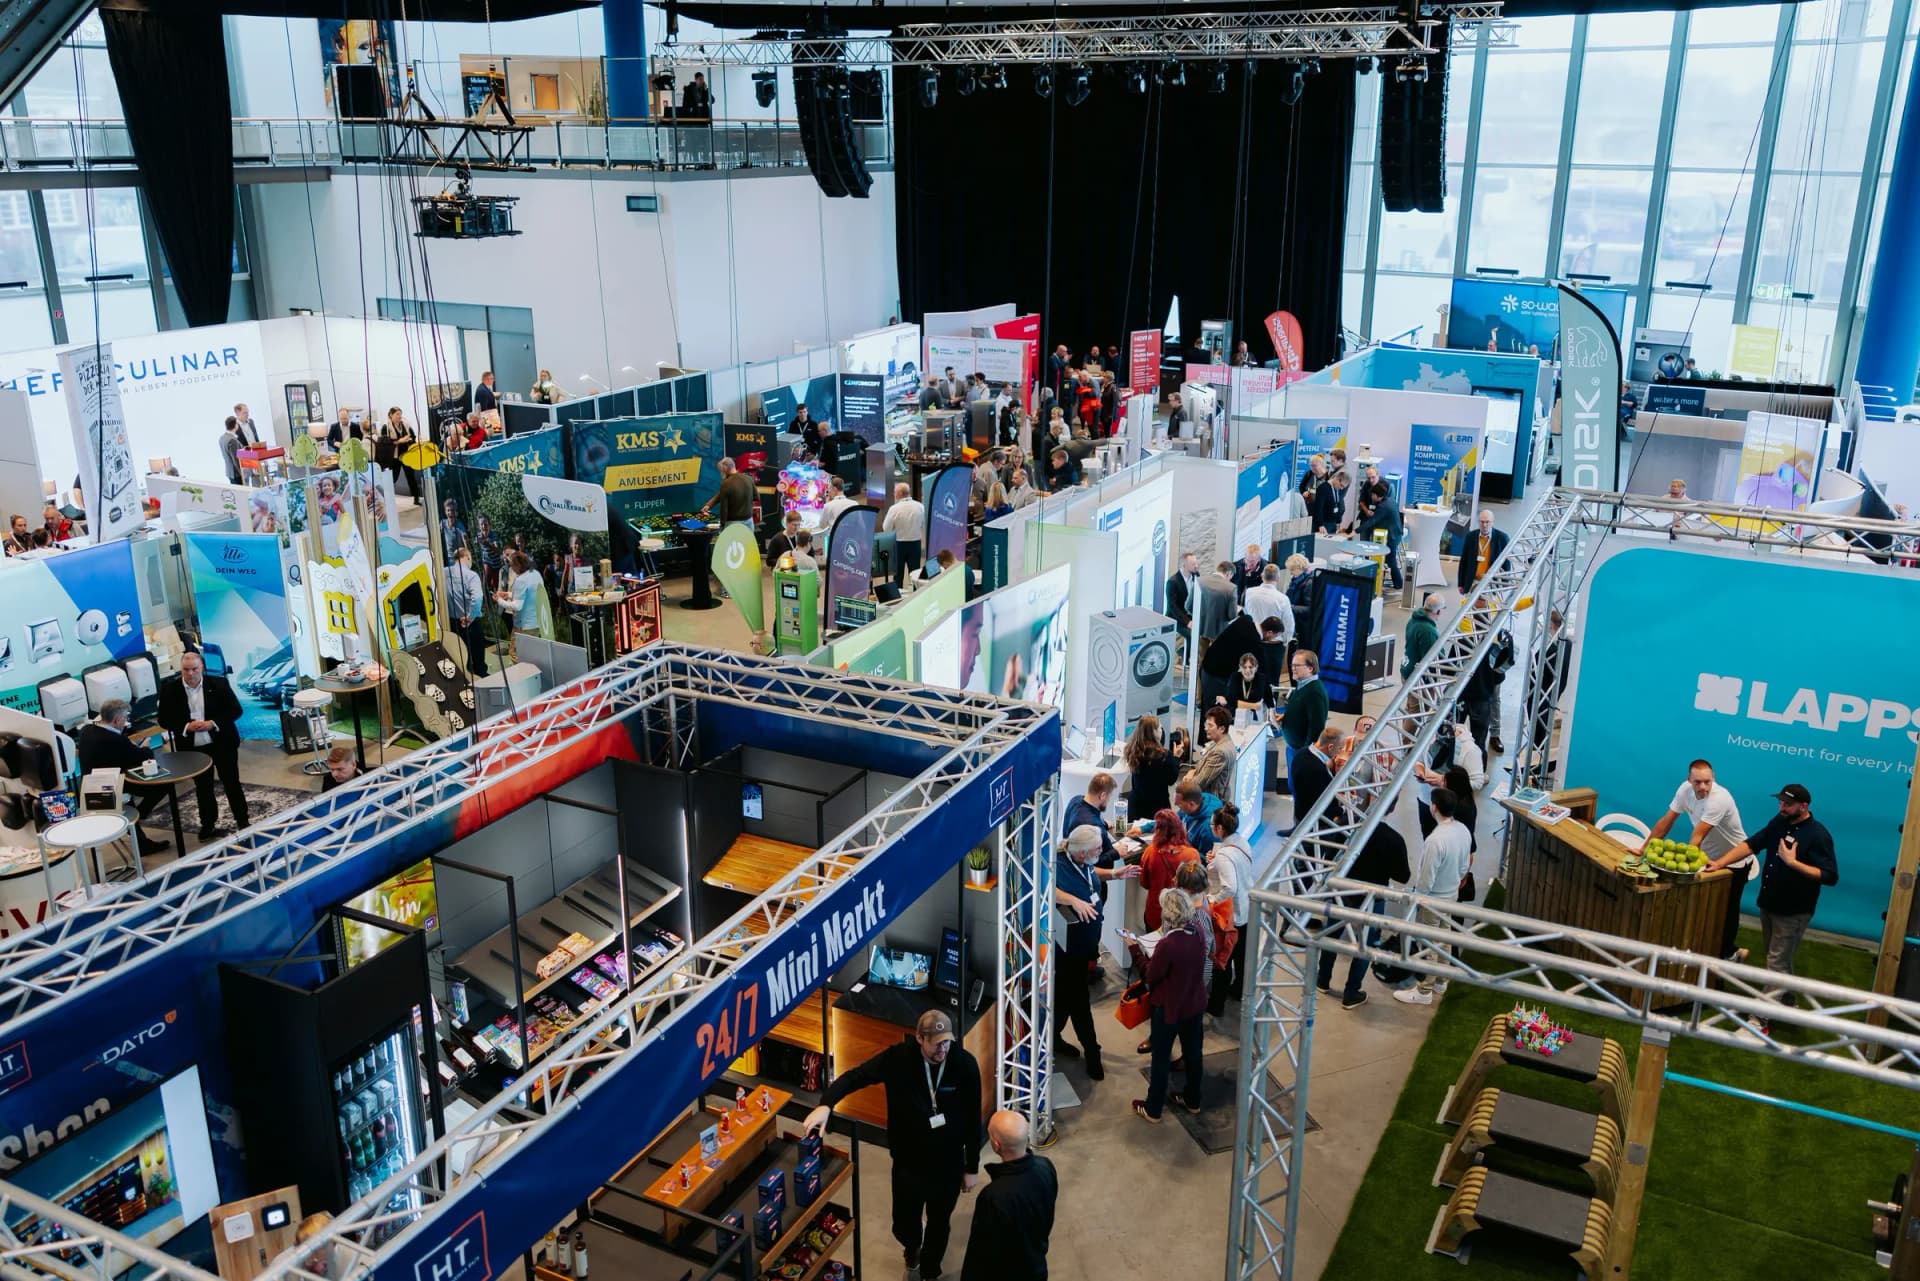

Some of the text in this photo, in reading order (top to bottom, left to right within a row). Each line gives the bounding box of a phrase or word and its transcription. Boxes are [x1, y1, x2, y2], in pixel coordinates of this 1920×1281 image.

[616, 431, 659, 450] KMS
[498, 455, 526, 474] KMS
[618, 472, 687, 487] AMUSEMENT
[634, 499, 665, 509] FLIPPER
[216, 567, 235, 575] DEIN
[1335, 594, 1350, 661] KEMMLIT
[1727, 733, 1815, 759] Movement
[1819, 749, 1842, 762] for
[1846, 756, 1893, 773] every
[696, 879, 887, 1081] 24/7 Mini Markt
[103, 1021, 166, 1065] DATO
[432, 1238, 470, 1281] HT
